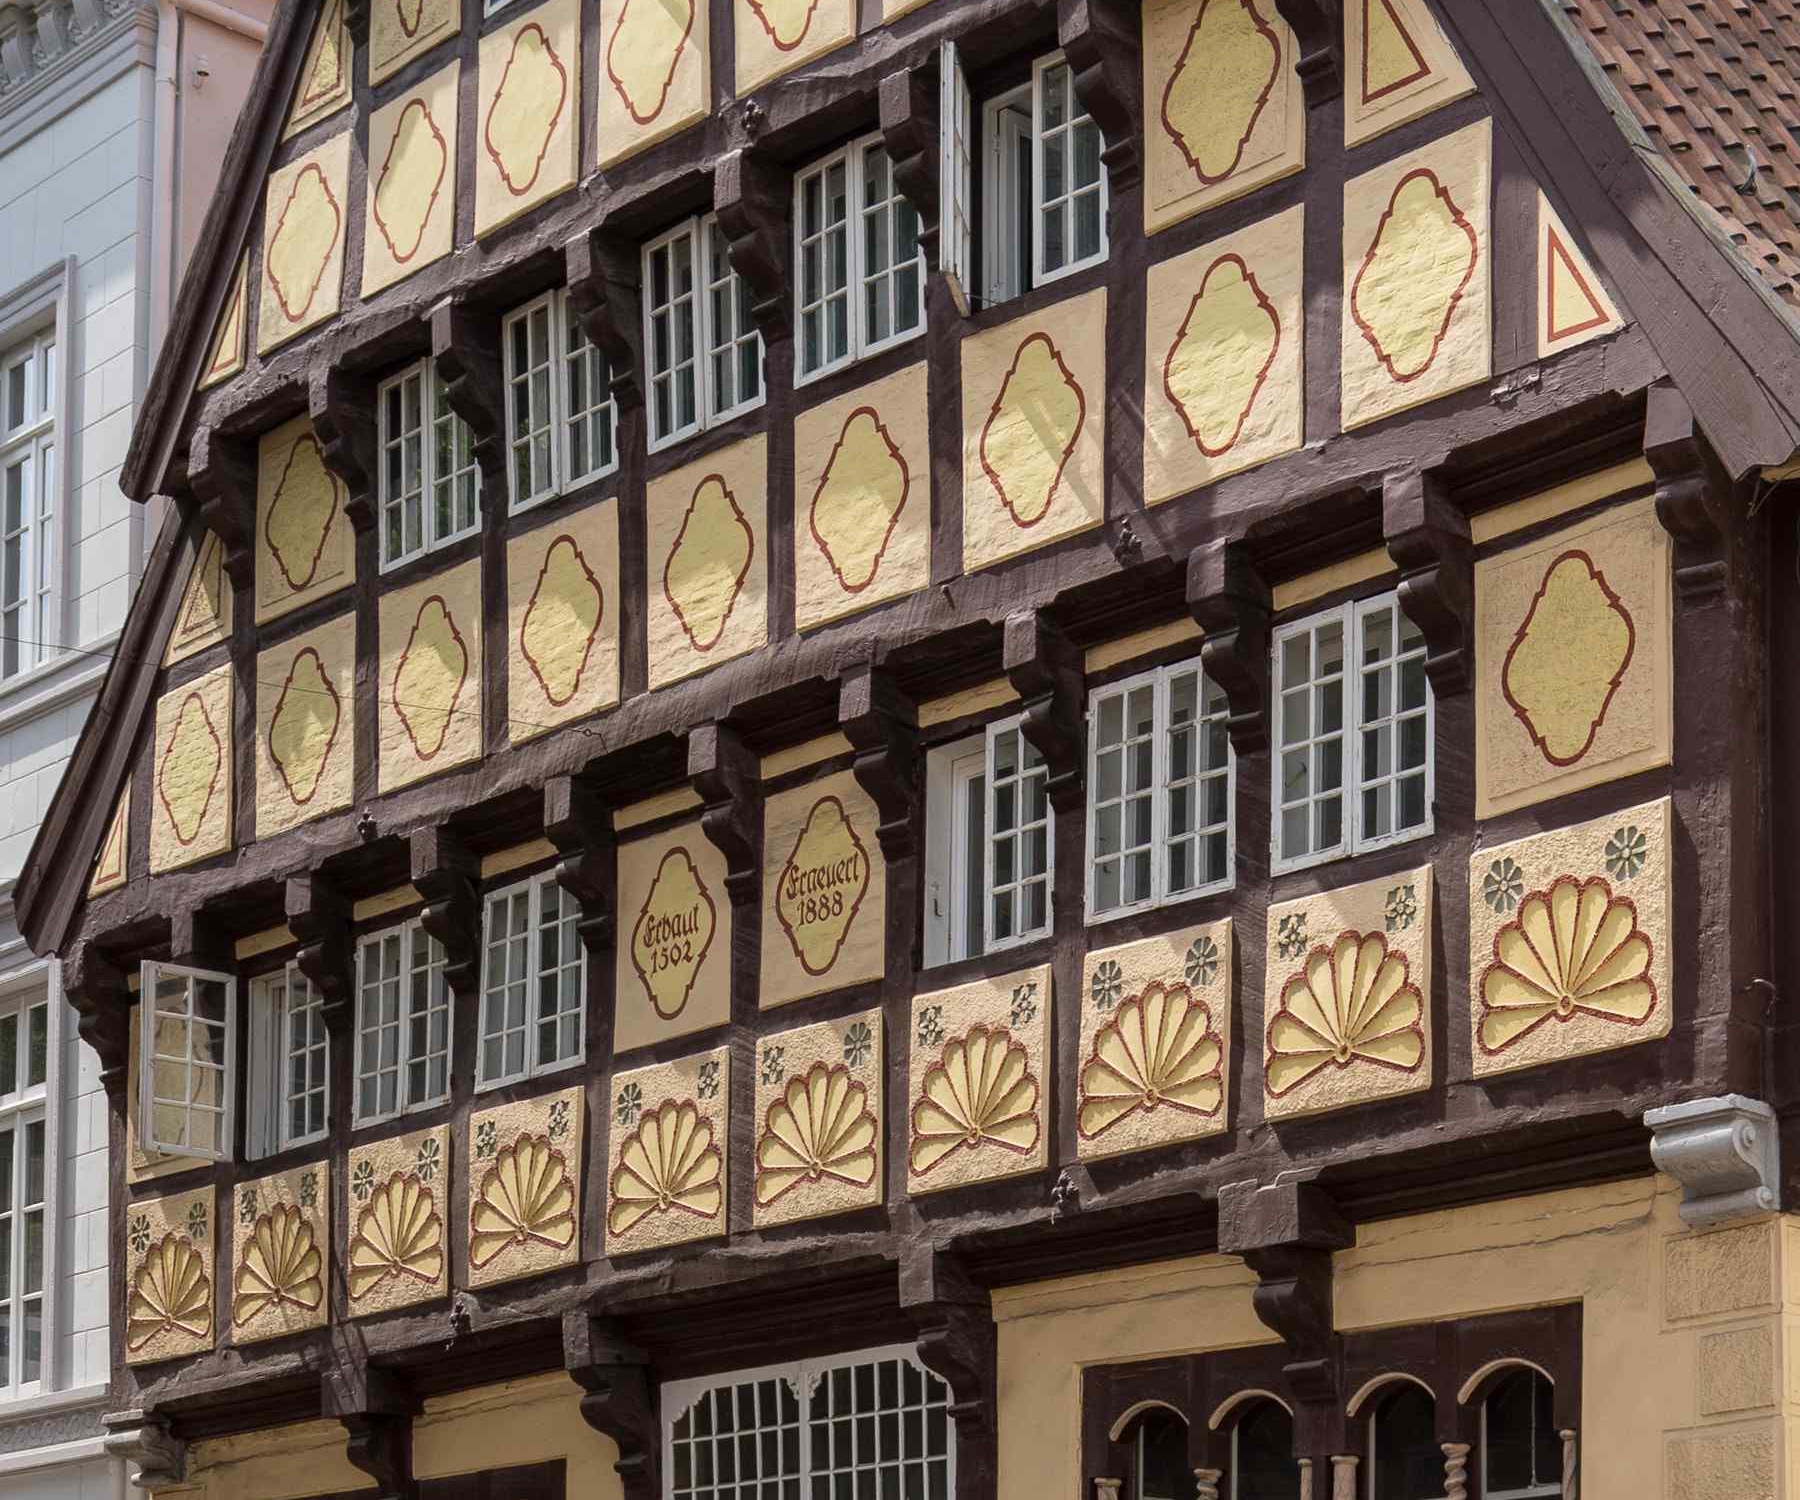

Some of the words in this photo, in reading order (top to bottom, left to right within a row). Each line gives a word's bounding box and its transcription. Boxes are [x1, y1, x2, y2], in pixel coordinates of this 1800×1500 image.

[644, 903, 699, 948] Erbaut
[797, 890, 843, 927] 1888
[650, 938, 693, 975] 1502
